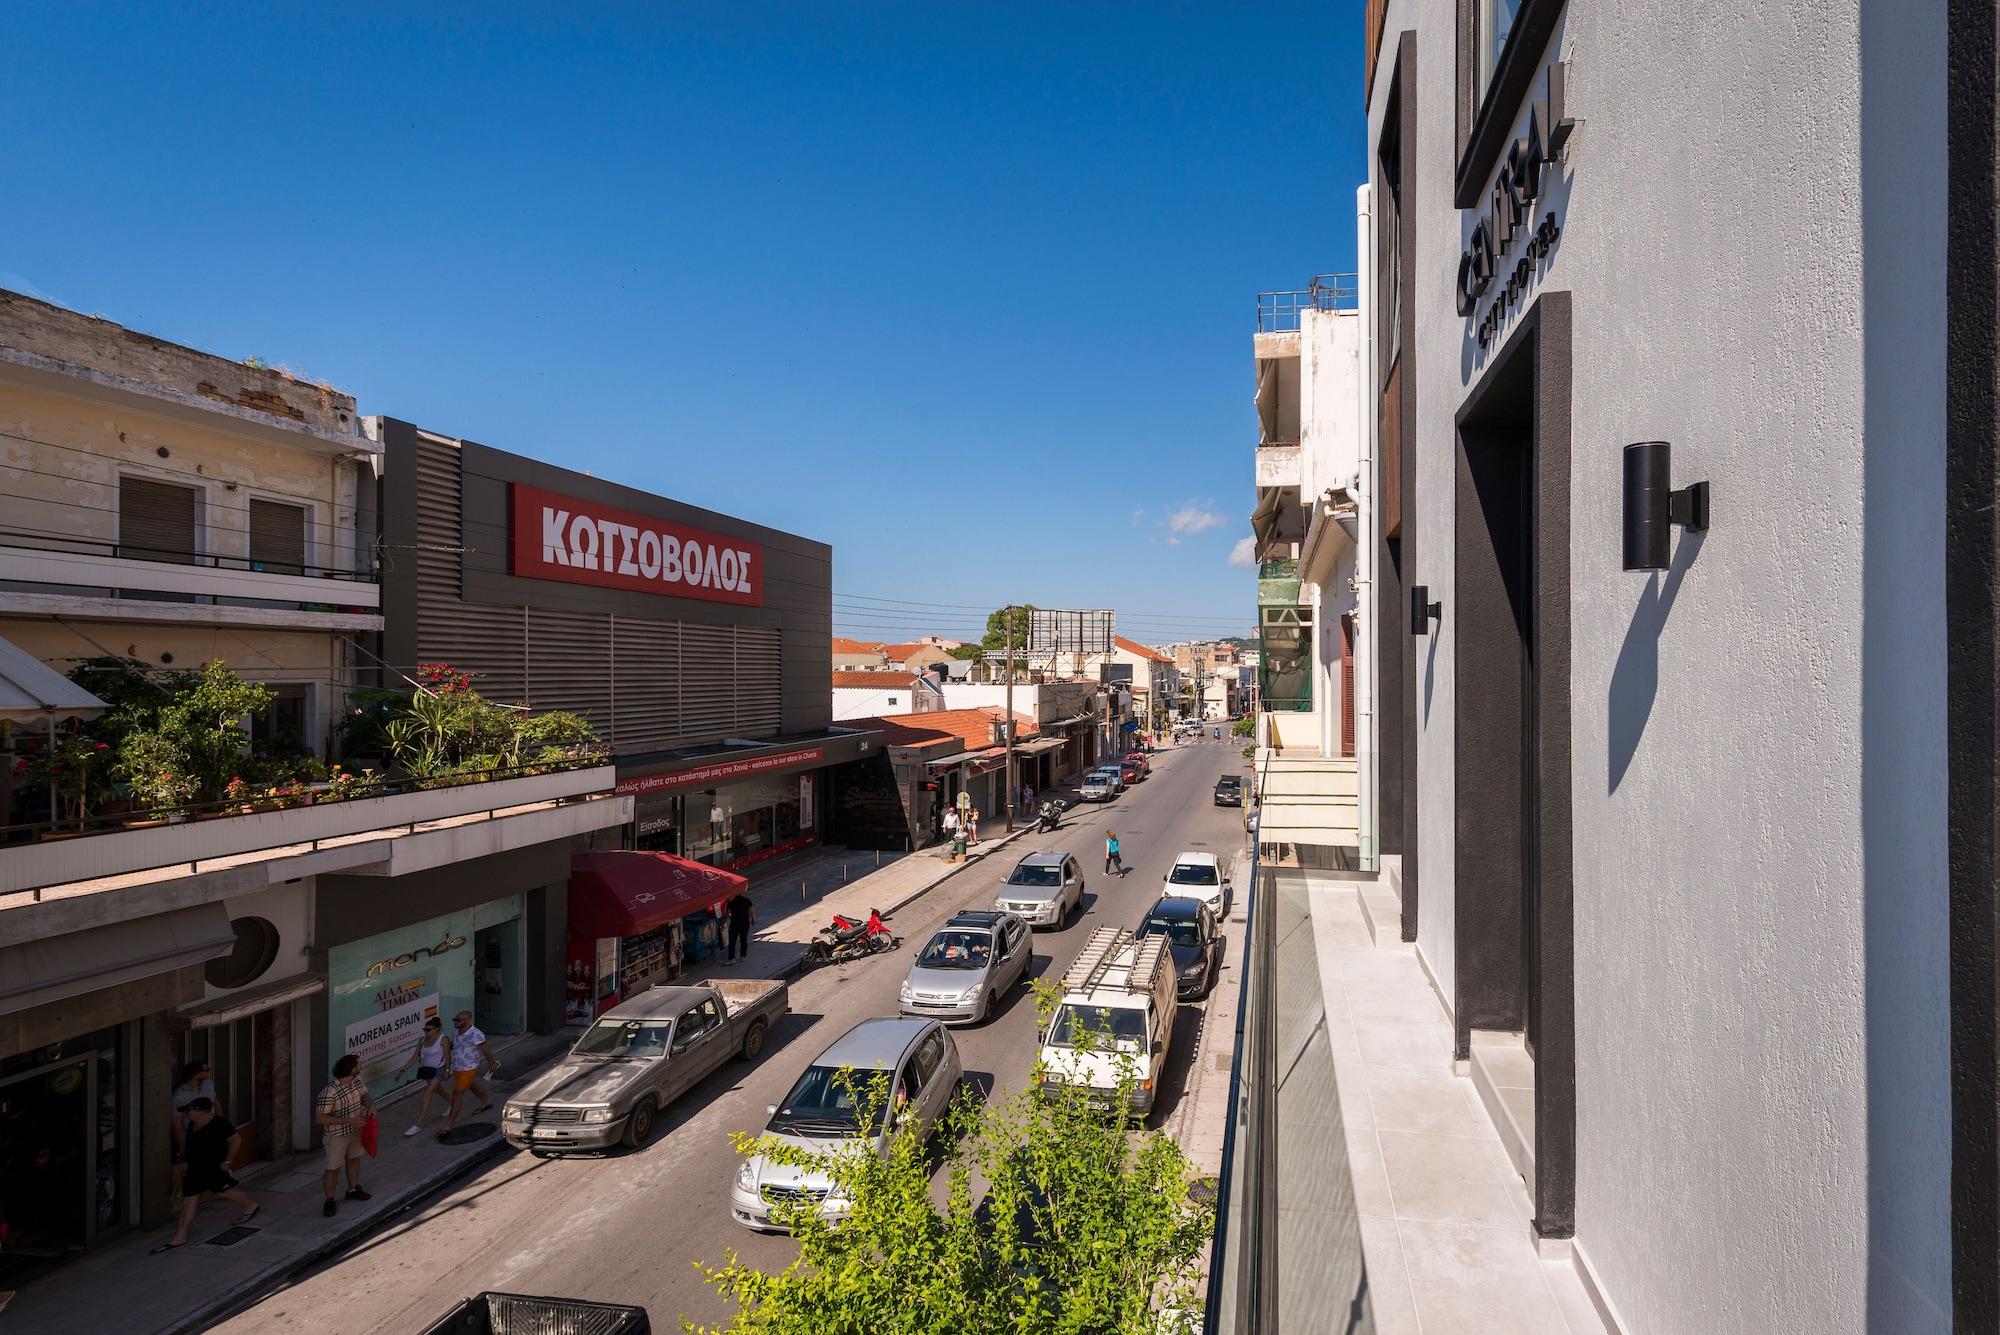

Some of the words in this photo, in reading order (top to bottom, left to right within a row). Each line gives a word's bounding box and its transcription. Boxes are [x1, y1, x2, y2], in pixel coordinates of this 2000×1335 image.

[542, 506, 752, 594] ΚΩΤΣΟΒΟΛΟΣ
[640, 777, 663, 790] ήλθατε
[665, 775, 677, 785] στο
[711, 770, 722, 779] μας
[723, 767, 732, 776] στα
[349, 1023, 393, 1049] MORENA
[395, 1011, 420, 1031] SPAIN
